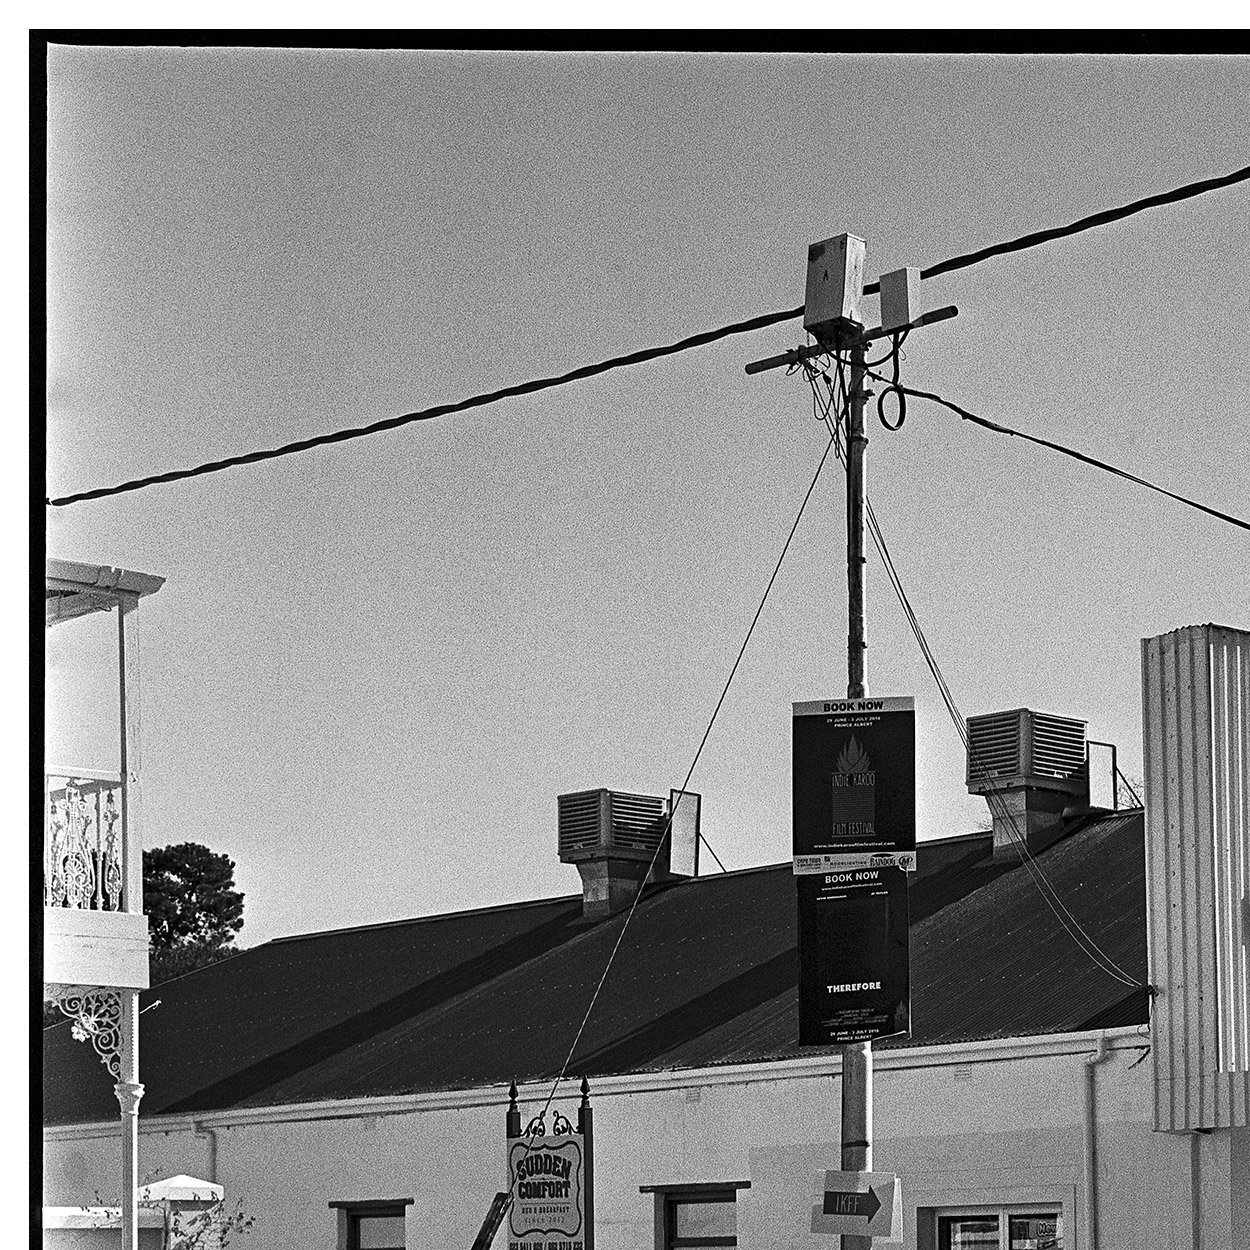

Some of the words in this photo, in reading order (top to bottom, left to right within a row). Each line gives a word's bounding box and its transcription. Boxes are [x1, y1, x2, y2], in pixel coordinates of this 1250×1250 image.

[824, 702, 855, 712] BOOK
[858, 701, 883, 711] NOW
[832, 773, 849, 787] INDIE
[853, 772, 875, 786] KAROO
[832, 823, 847, 835] FILM
[848, 822, 875, 834] FESTIVAL
[825, 873, 853, 884] BOOK
[855, 871, 879, 881] NOW
[827, 981, 881, 993] THEREFORE
[516, 1154, 573, 1180] SUDDEN
[518, 1181, 571, 1199] COMFORT
[539, 1206, 570, 1214] BREAKFAST
[835, 1194, 861, 1213] IKFF
